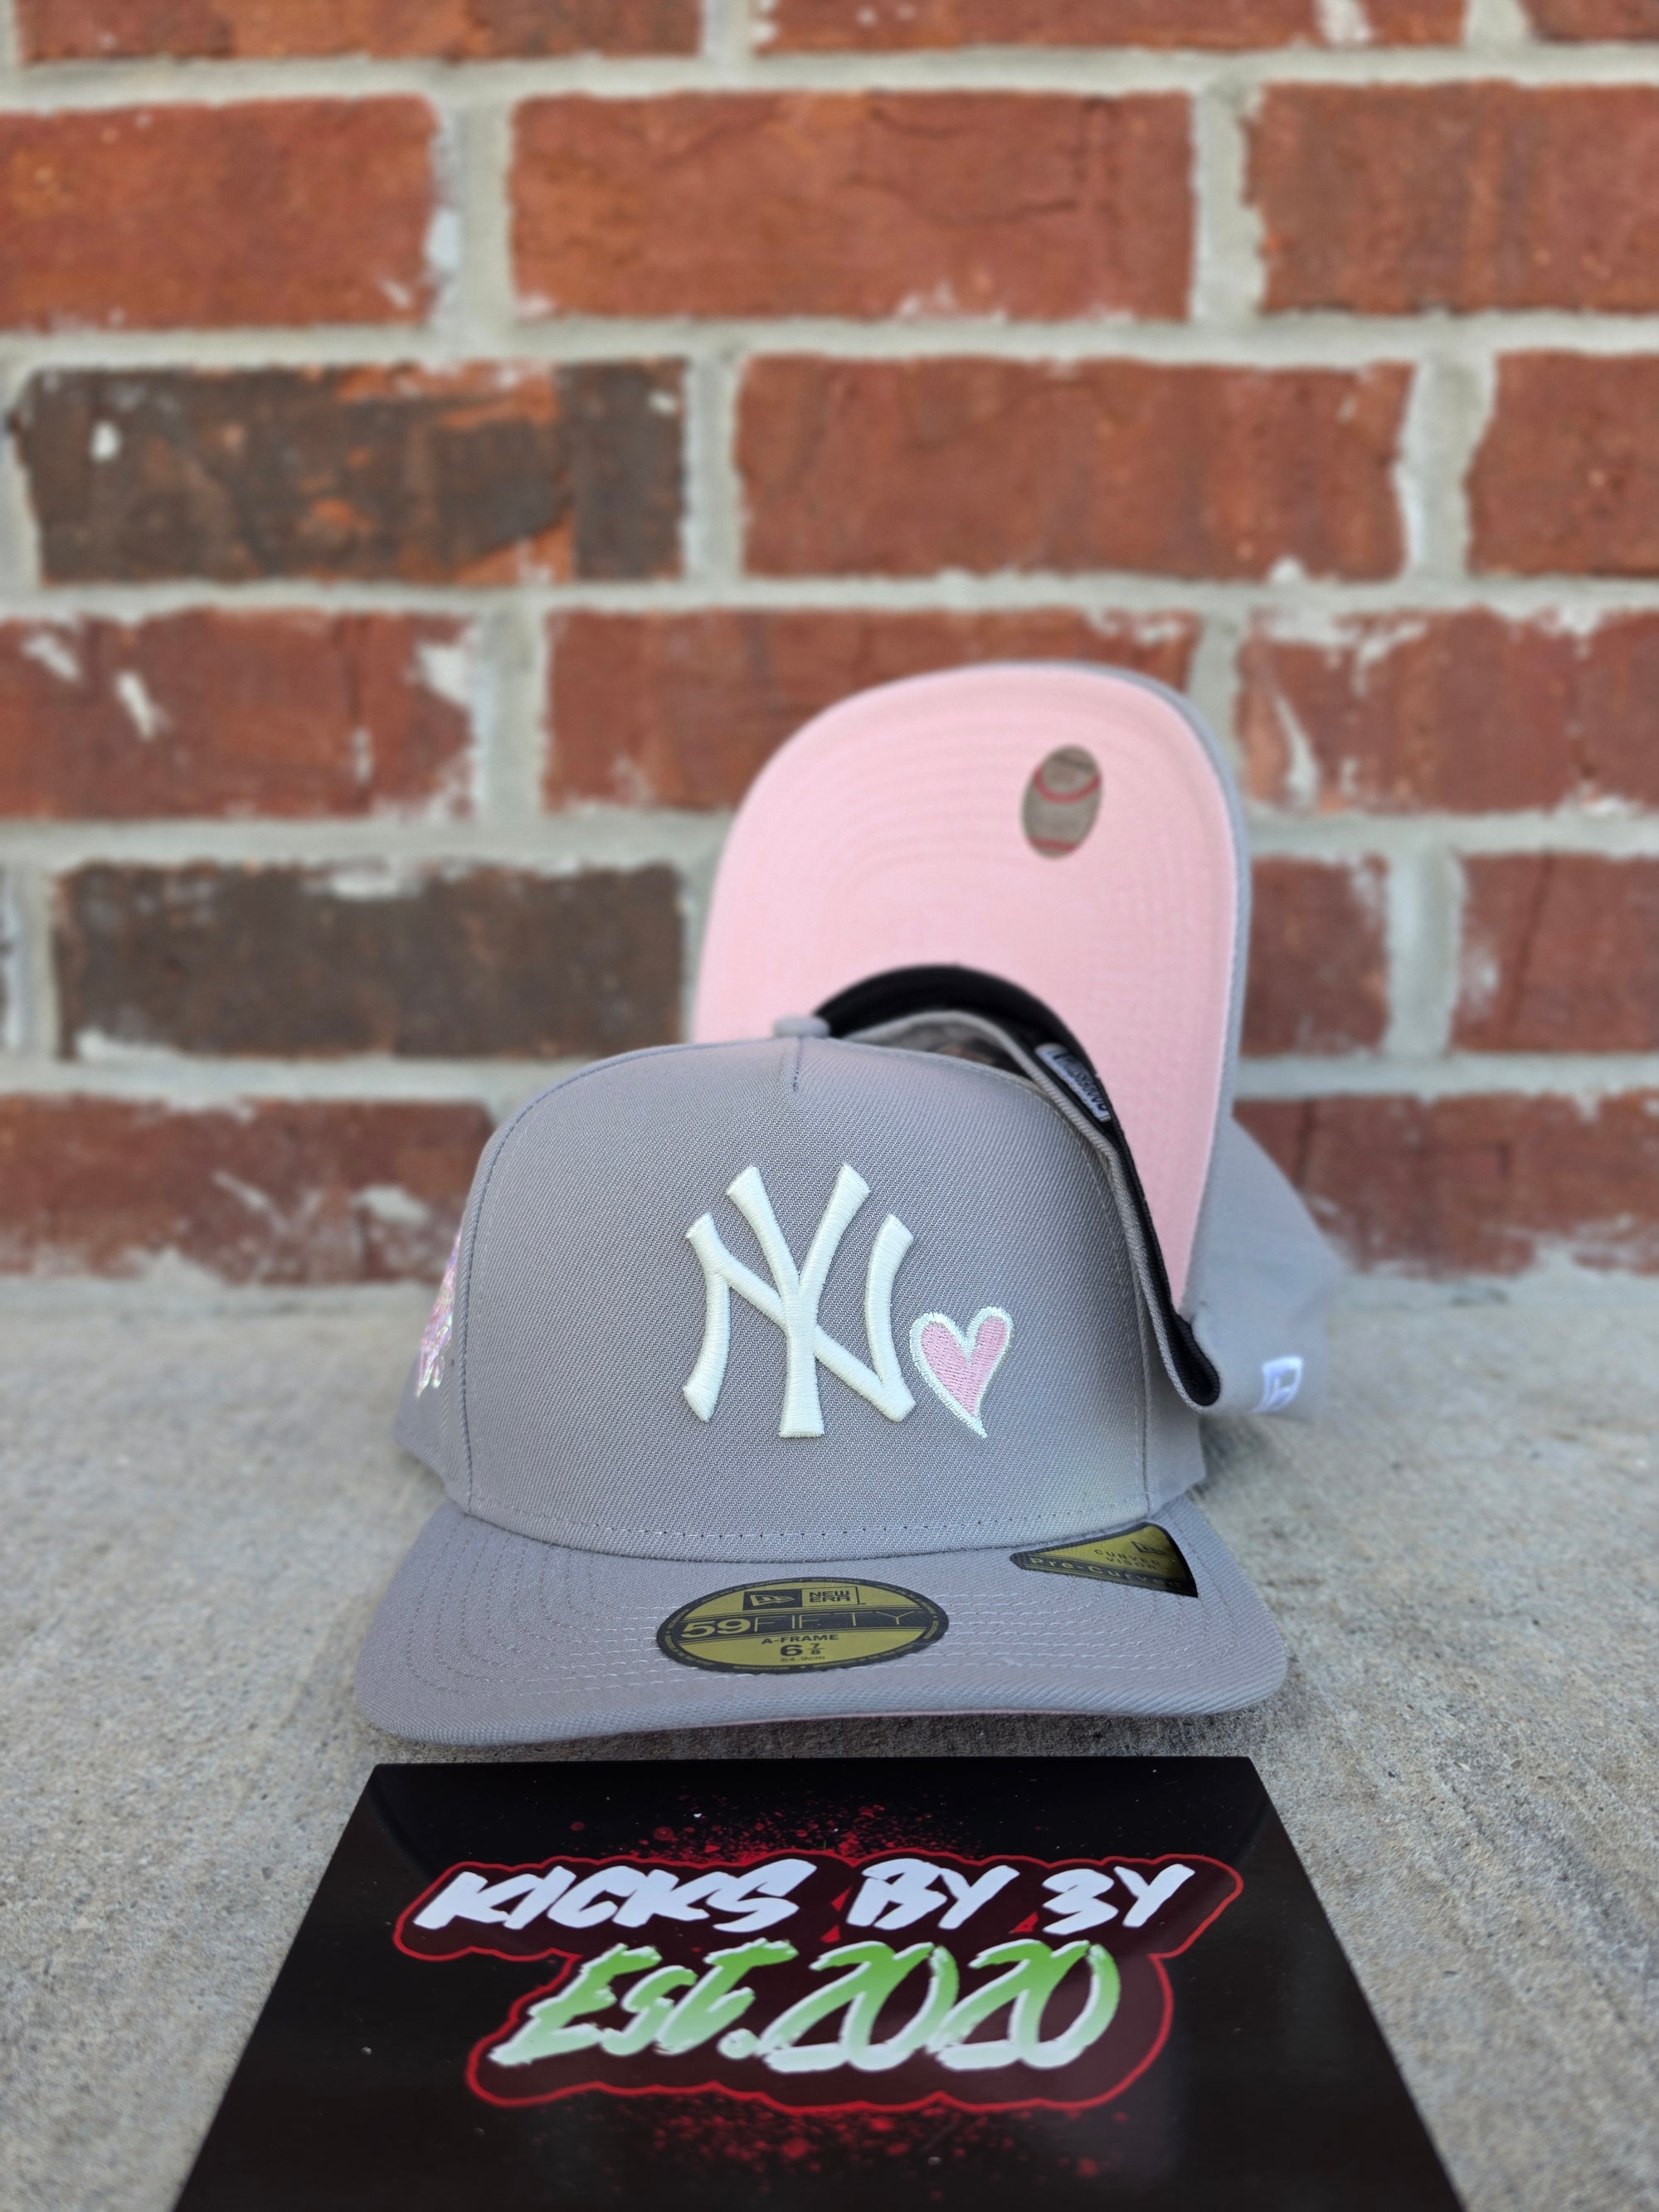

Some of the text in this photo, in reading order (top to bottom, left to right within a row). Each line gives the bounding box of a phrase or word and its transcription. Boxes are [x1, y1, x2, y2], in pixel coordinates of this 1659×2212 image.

[682, 1163, 917, 1438] NY
[680, 1610, 915, 1639] 59FIFTY
[761, 1634, 839, 1645] A-FRAME
[780, 1644, 803, 1656] 6
[413, 1857, 1196, 1936] KICKS BY 3Y
